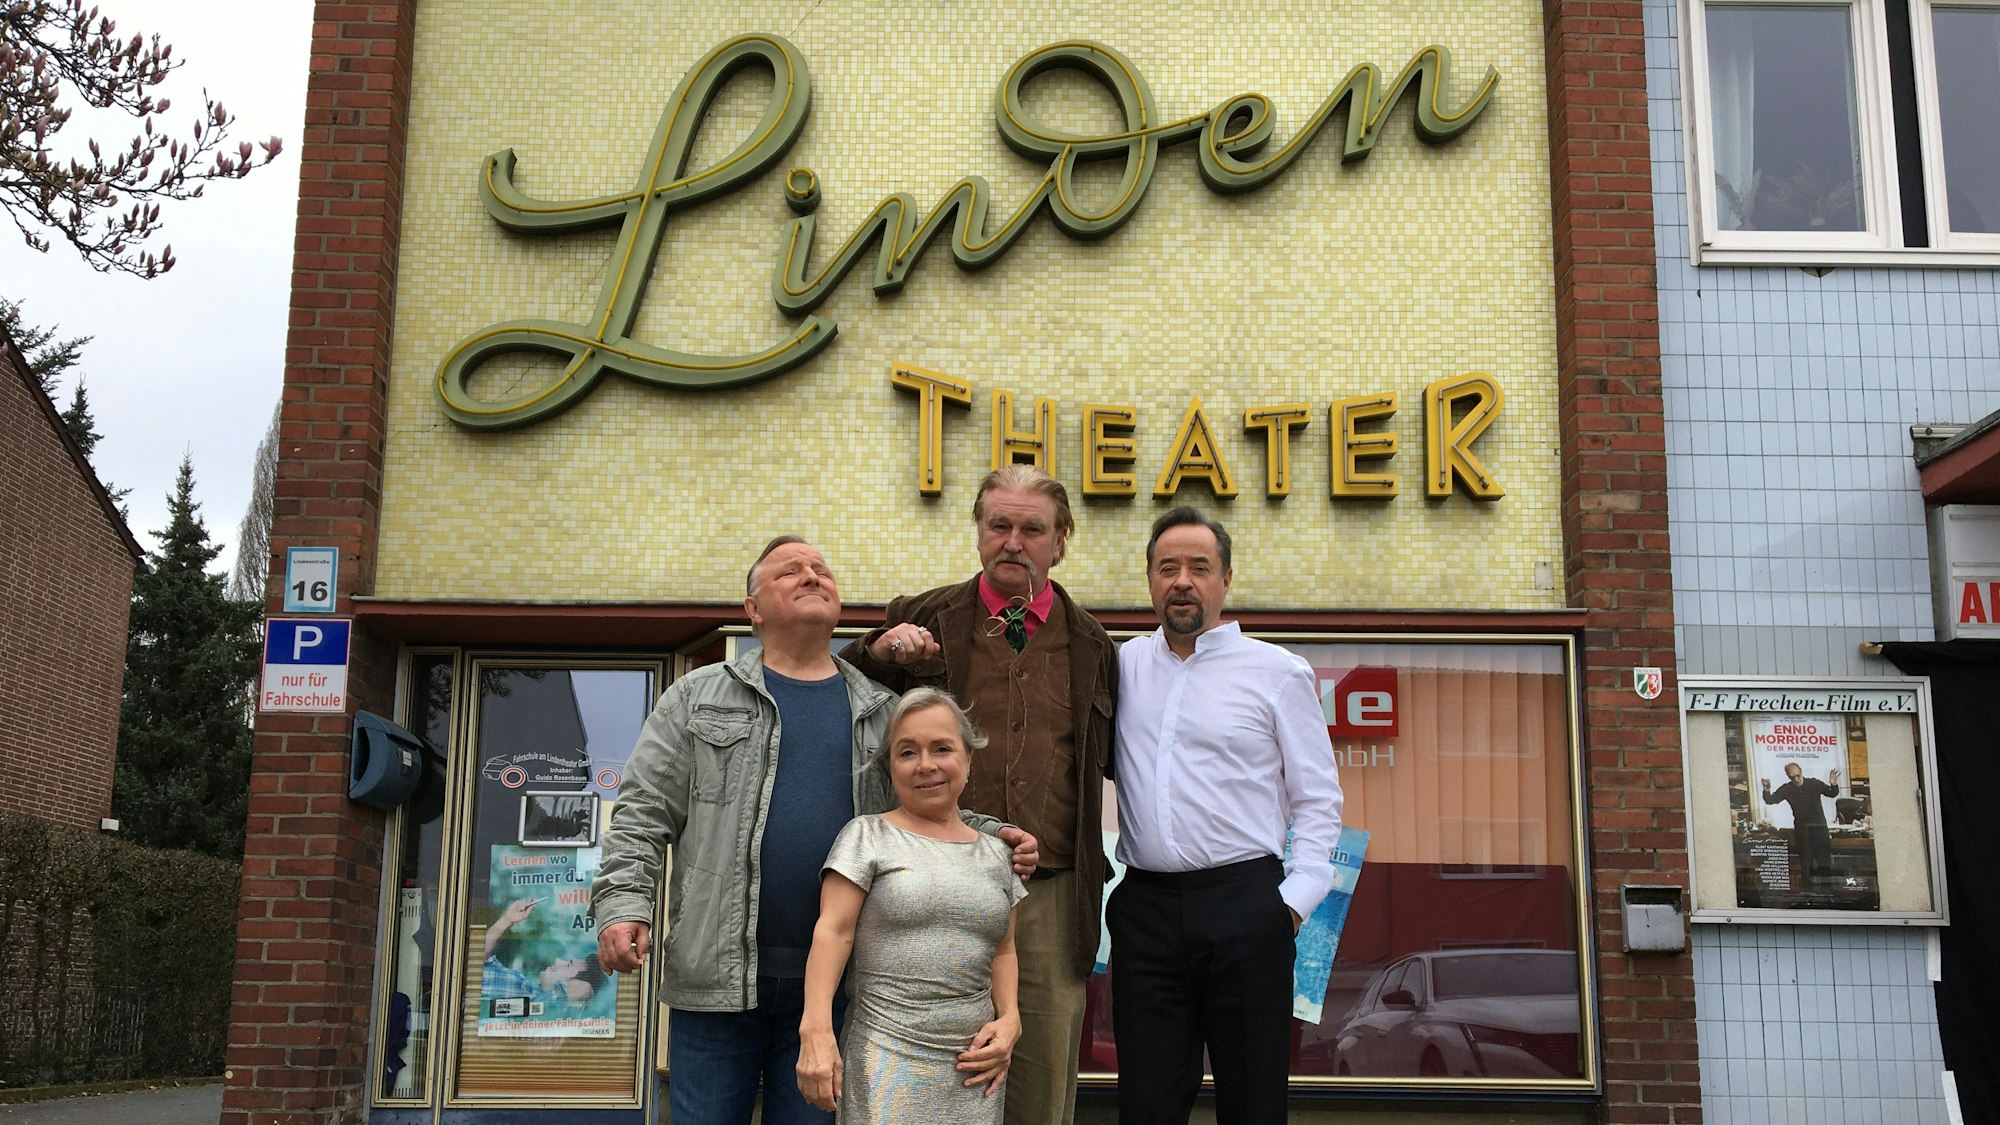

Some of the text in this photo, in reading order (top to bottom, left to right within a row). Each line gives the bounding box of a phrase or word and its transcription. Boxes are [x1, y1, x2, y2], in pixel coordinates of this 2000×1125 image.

[433, 33, 1501, 433] Linden
[892, 360, 1506, 500] THEATER
[292, 580, 328, 602] 16
[1959, 582, 2000, 623] A
[292, 625, 323, 661] P
[281, 673, 328, 687] nur für
[265, 692, 341, 707] Fahrschule
[1689, 693, 1913, 712] F-F Frechen-Film e.V.
[1773, 724, 1817, 735] ENNIO
[1755, 734, 1837, 746] MORRICONE
[512, 752, 539, 764] Fahrschule
[539, 753, 547, 761] am
[547, 753, 578, 768] Lindentheater
[504, 855, 568, 866] Lernen wo
[512, 871, 561, 885] immer
[511, 1020, 520, 1030] in
[522, 1019, 553, 1030] deiner
[556, 1017, 609, 1028] Fahrschule
